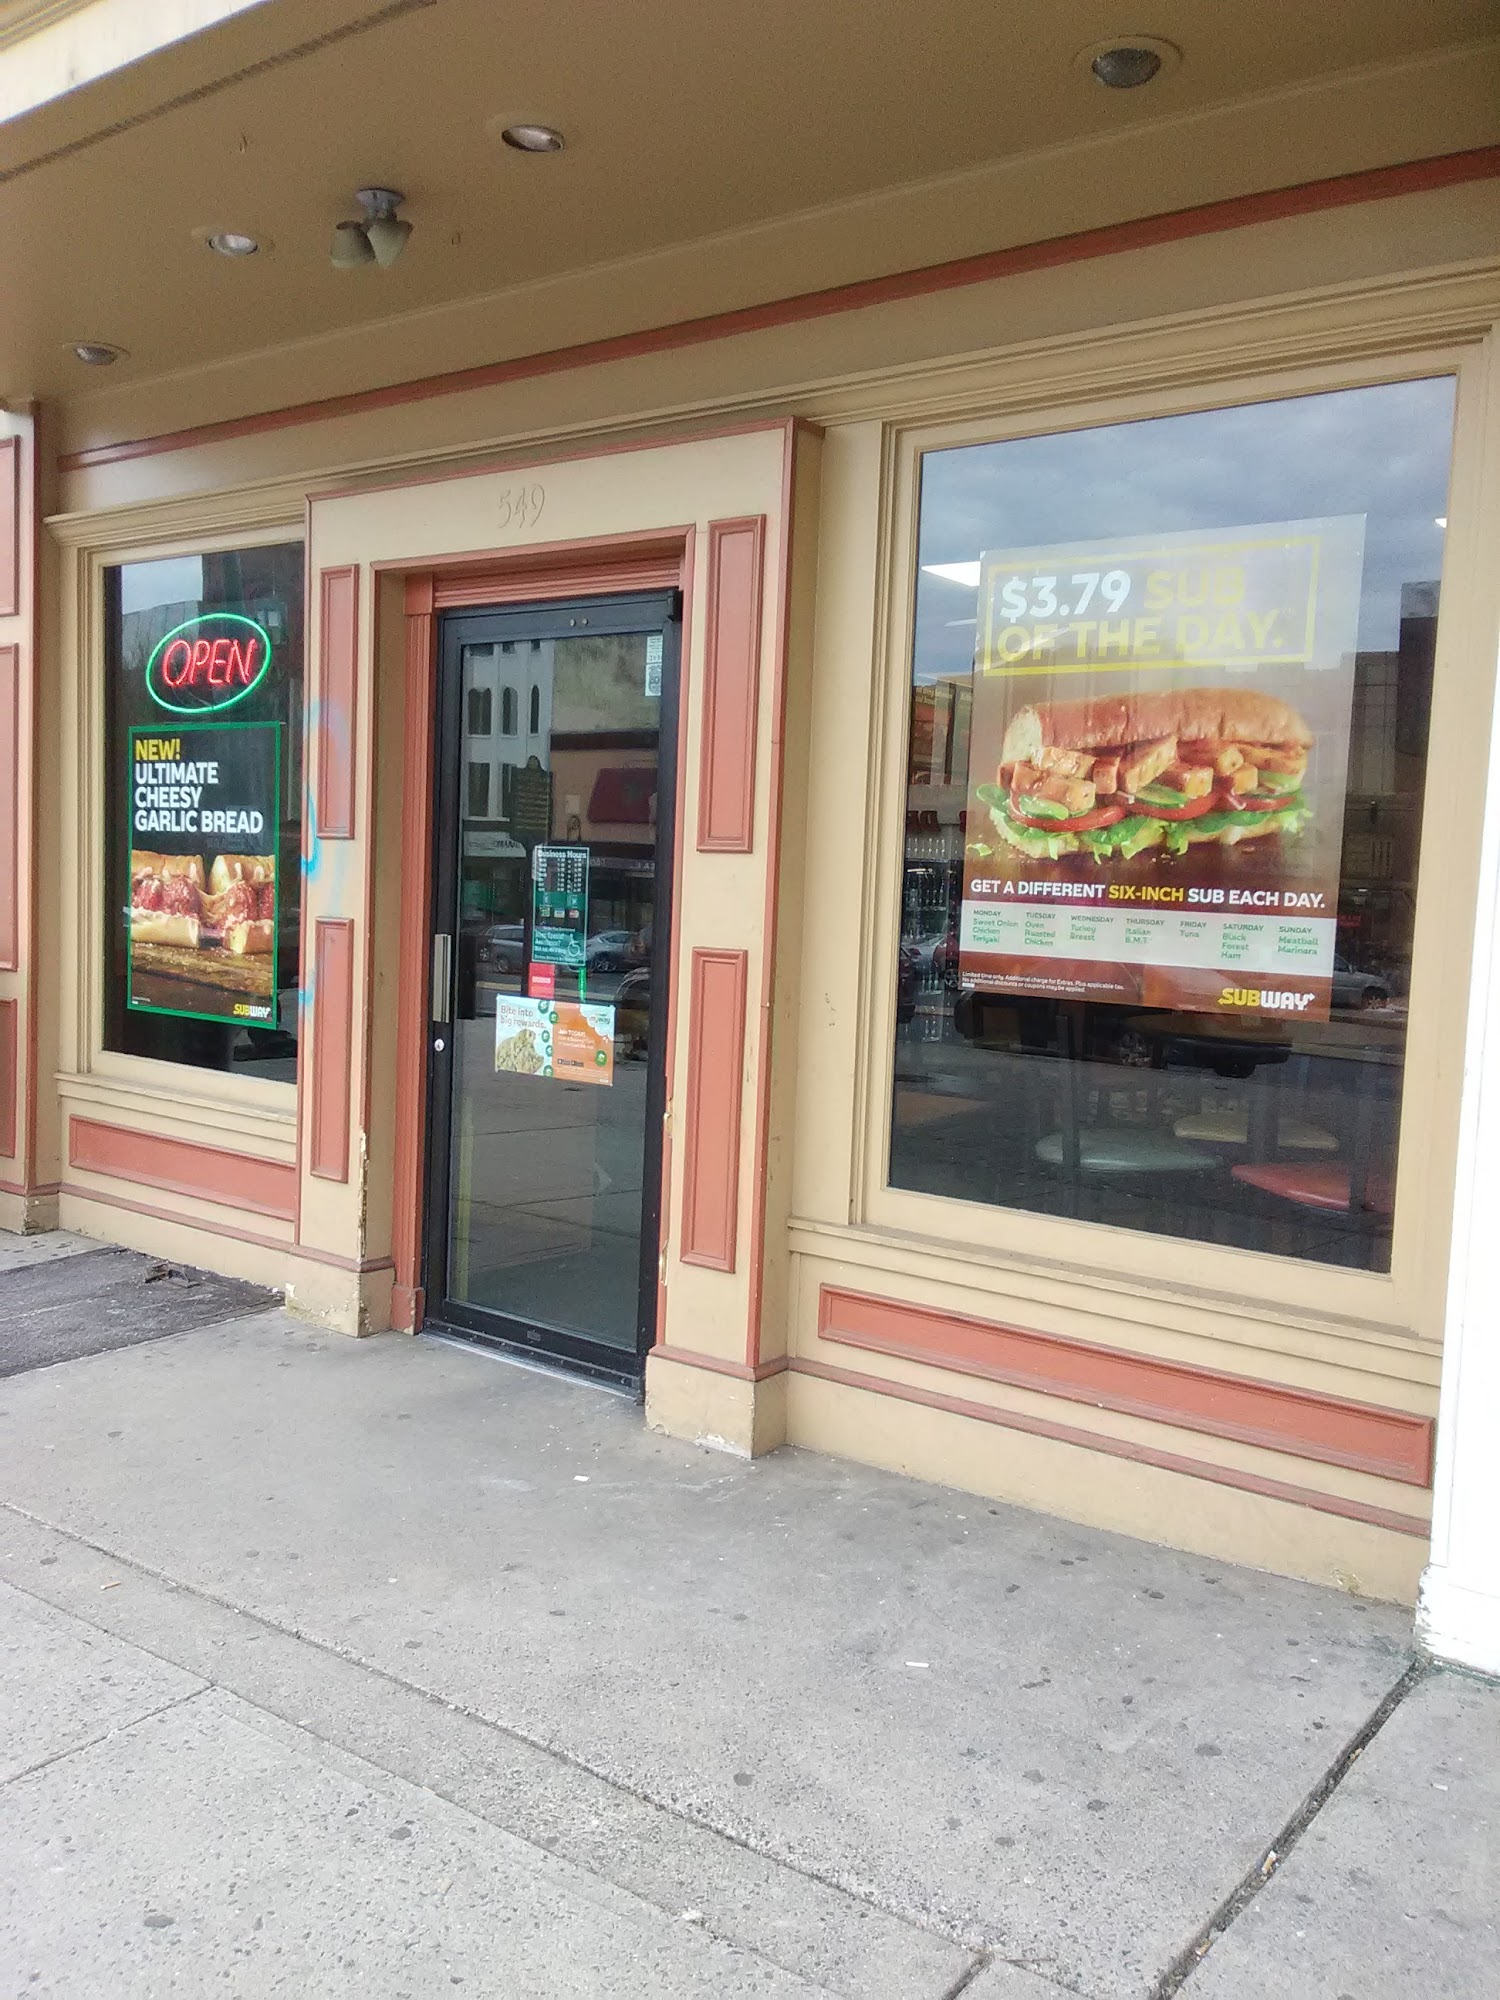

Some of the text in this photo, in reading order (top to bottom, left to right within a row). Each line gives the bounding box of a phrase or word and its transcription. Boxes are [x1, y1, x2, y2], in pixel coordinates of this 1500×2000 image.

[498, 484, 545, 528] 549
[1000, 566, 1246, 624] $3.79 SUB
[998, 623, 1058, 662] OF
[1070, 617, 1162, 658] THE
[161, 637, 259, 687] OPEN
[135, 739, 181, 761] NEW!
[134, 762, 219, 785] ULTIMATE
[134, 786, 203, 809] CHEESY
[134, 810, 264, 834] GARLIC BREAD
[537, 850, 587, 859] Business Hours
[970, 878, 1325, 909] GET A DIFFERENT SIX-INCH SUB EACH DAY.
[973, 909, 1001, 917] MONDAY
[1026, 911, 1057, 920] TUESDAY
[973, 918, 1019, 927] Sweet Onion
[1070, 915, 1115, 923] WEDNESDAY
[1126, 918, 1165, 927] THURSDAY
[1025, 921, 1044, 929] Oven
[1071, 924, 1097, 934] Turkey
[1180, 921, 1207, 929] FRIDAY
[1223, 923, 1264, 932] SATURDAY
[972, 927, 1000, 935] Chicken
[1024, 929, 1056, 938] Roasted
[1125, 928, 1151, 936] Italian
[1180, 930, 1199, 938] Tuna
[1279, 926, 1312, 934] SUNDAY
[1070, 932, 1095, 941] Breast
[1222, 933, 1246, 942] Black
[1278, 936, 1319, 946] Meatball
[1024, 938, 1053, 947] Chicken
[1221, 941, 1249, 951] Forest
[1278, 945, 1318, 955] Marinara
[1221, 951, 1241, 959] Ham
[1005, 974, 1030, 982] Additional
[1218, 987, 1315, 1011] SUBWAY
[233, 1003, 271, 1019] SUBWAY
[501, 1005, 533, 1017] Bite into
[500, 1015, 547, 1030] big rewards.
